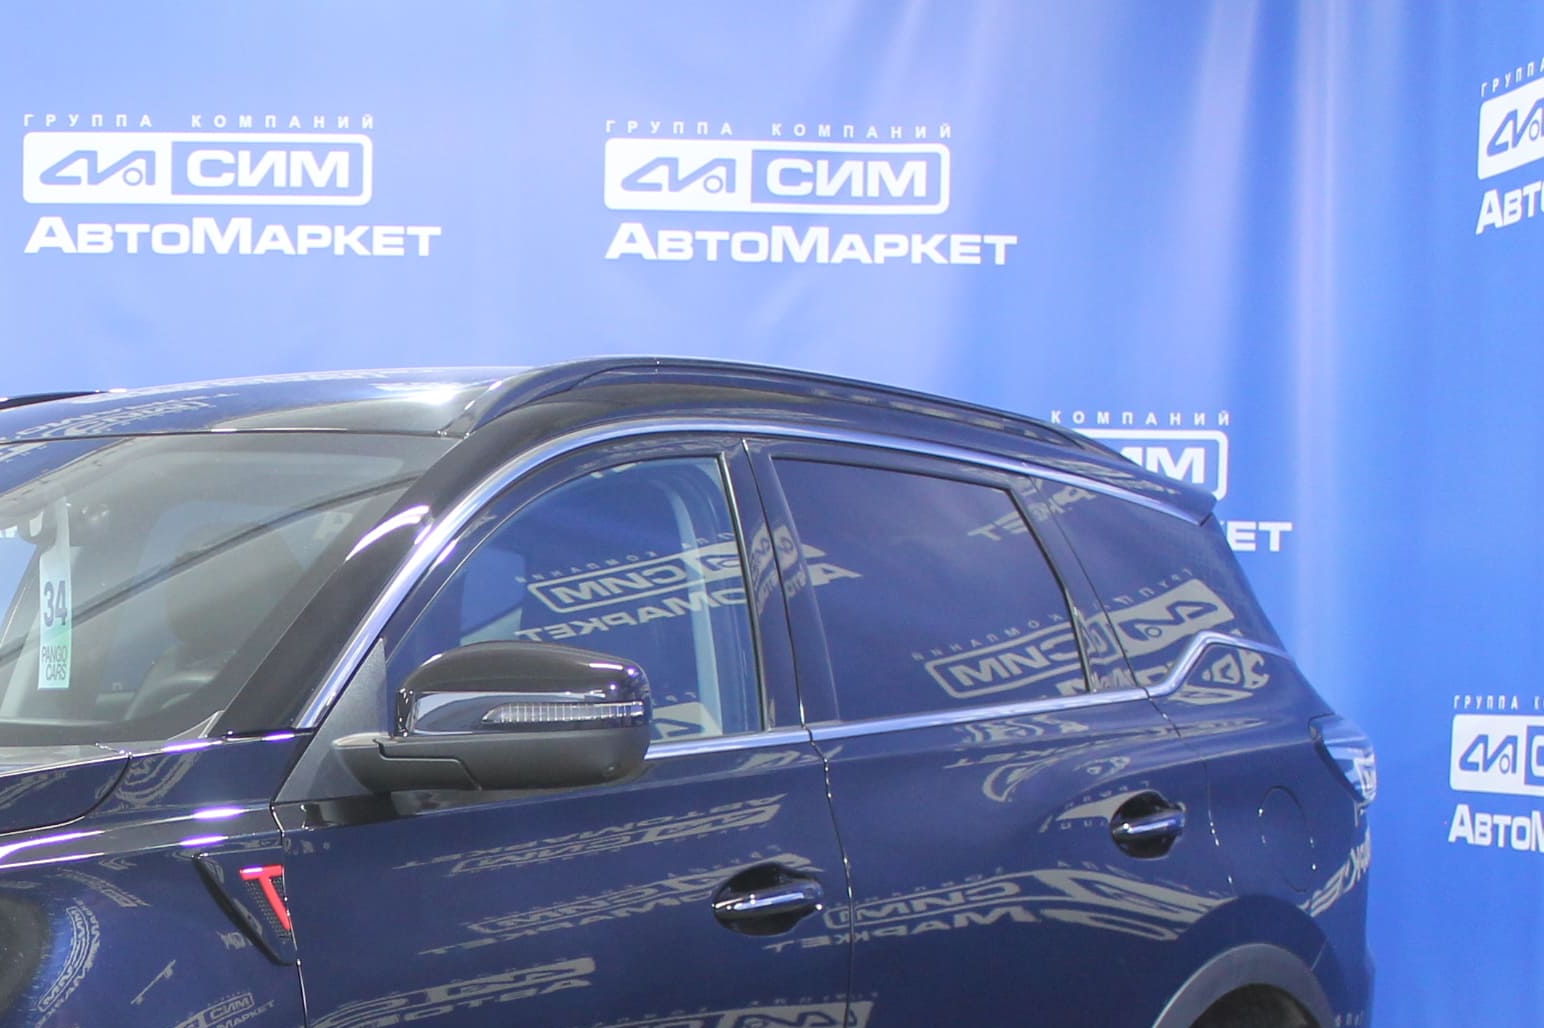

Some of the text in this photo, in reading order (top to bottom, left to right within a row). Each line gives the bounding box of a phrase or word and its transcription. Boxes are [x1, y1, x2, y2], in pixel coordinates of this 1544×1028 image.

[23, 113, 374, 129] ГРУППА КОМПАНИЙ
[605, 119, 952, 139] ГРУППА КОМПАНИЙ
[187, 149, 350, 188] СИМ
[766, 157, 928, 198] СИМ
[1051, 410, 1230, 426] КОМПАНИЙ
[43, 580, 68, 628] 34
[41, 645, 67, 662] PANGO
[45, 663, 67, 681] CARS
[1453, 694, 1519, 710] ГРУППА
